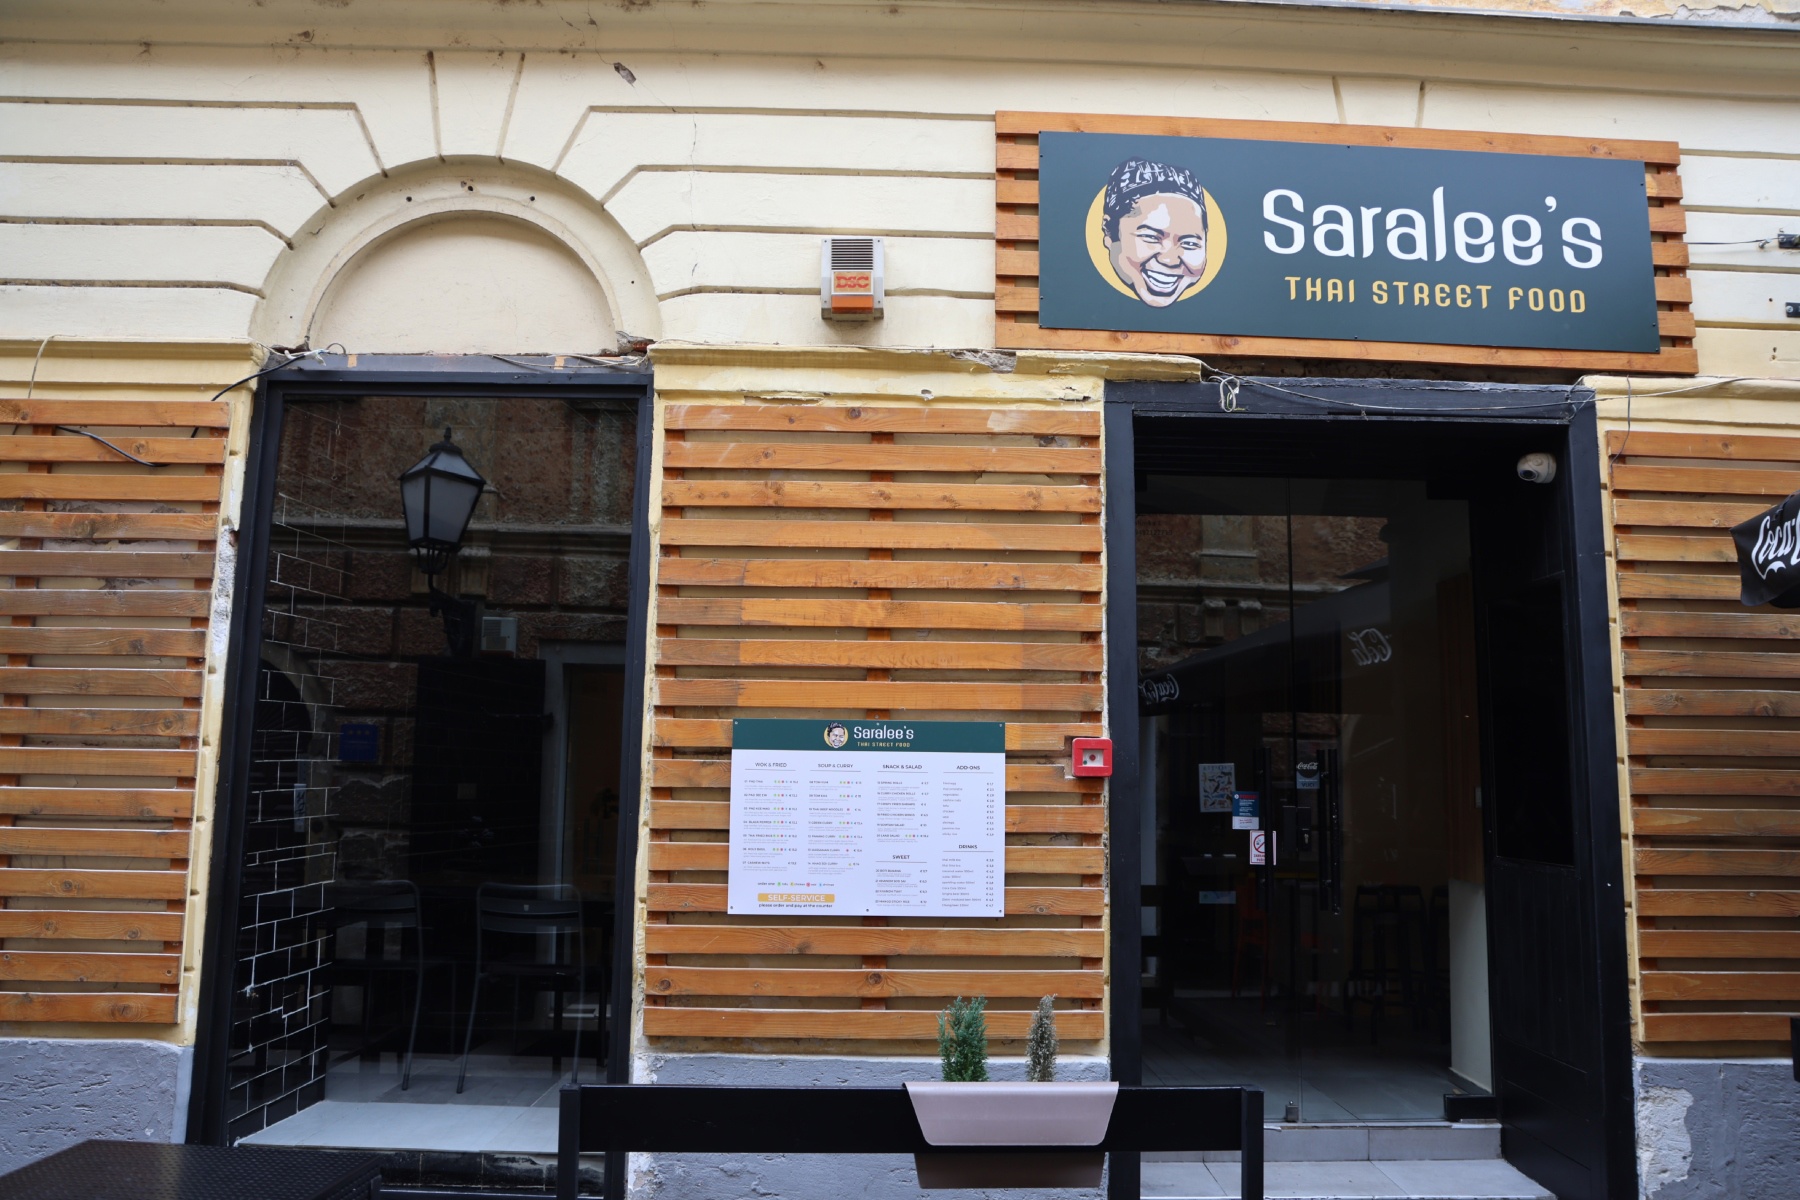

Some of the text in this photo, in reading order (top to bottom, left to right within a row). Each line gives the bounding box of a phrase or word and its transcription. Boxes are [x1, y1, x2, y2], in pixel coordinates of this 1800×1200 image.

[1263, 186, 1602, 268] Saralee's
[836, 276, 869, 288] DSC
[1285, 277, 1586, 313] THAI STREET FOOD
[854, 725, 914, 740] Saralee's
